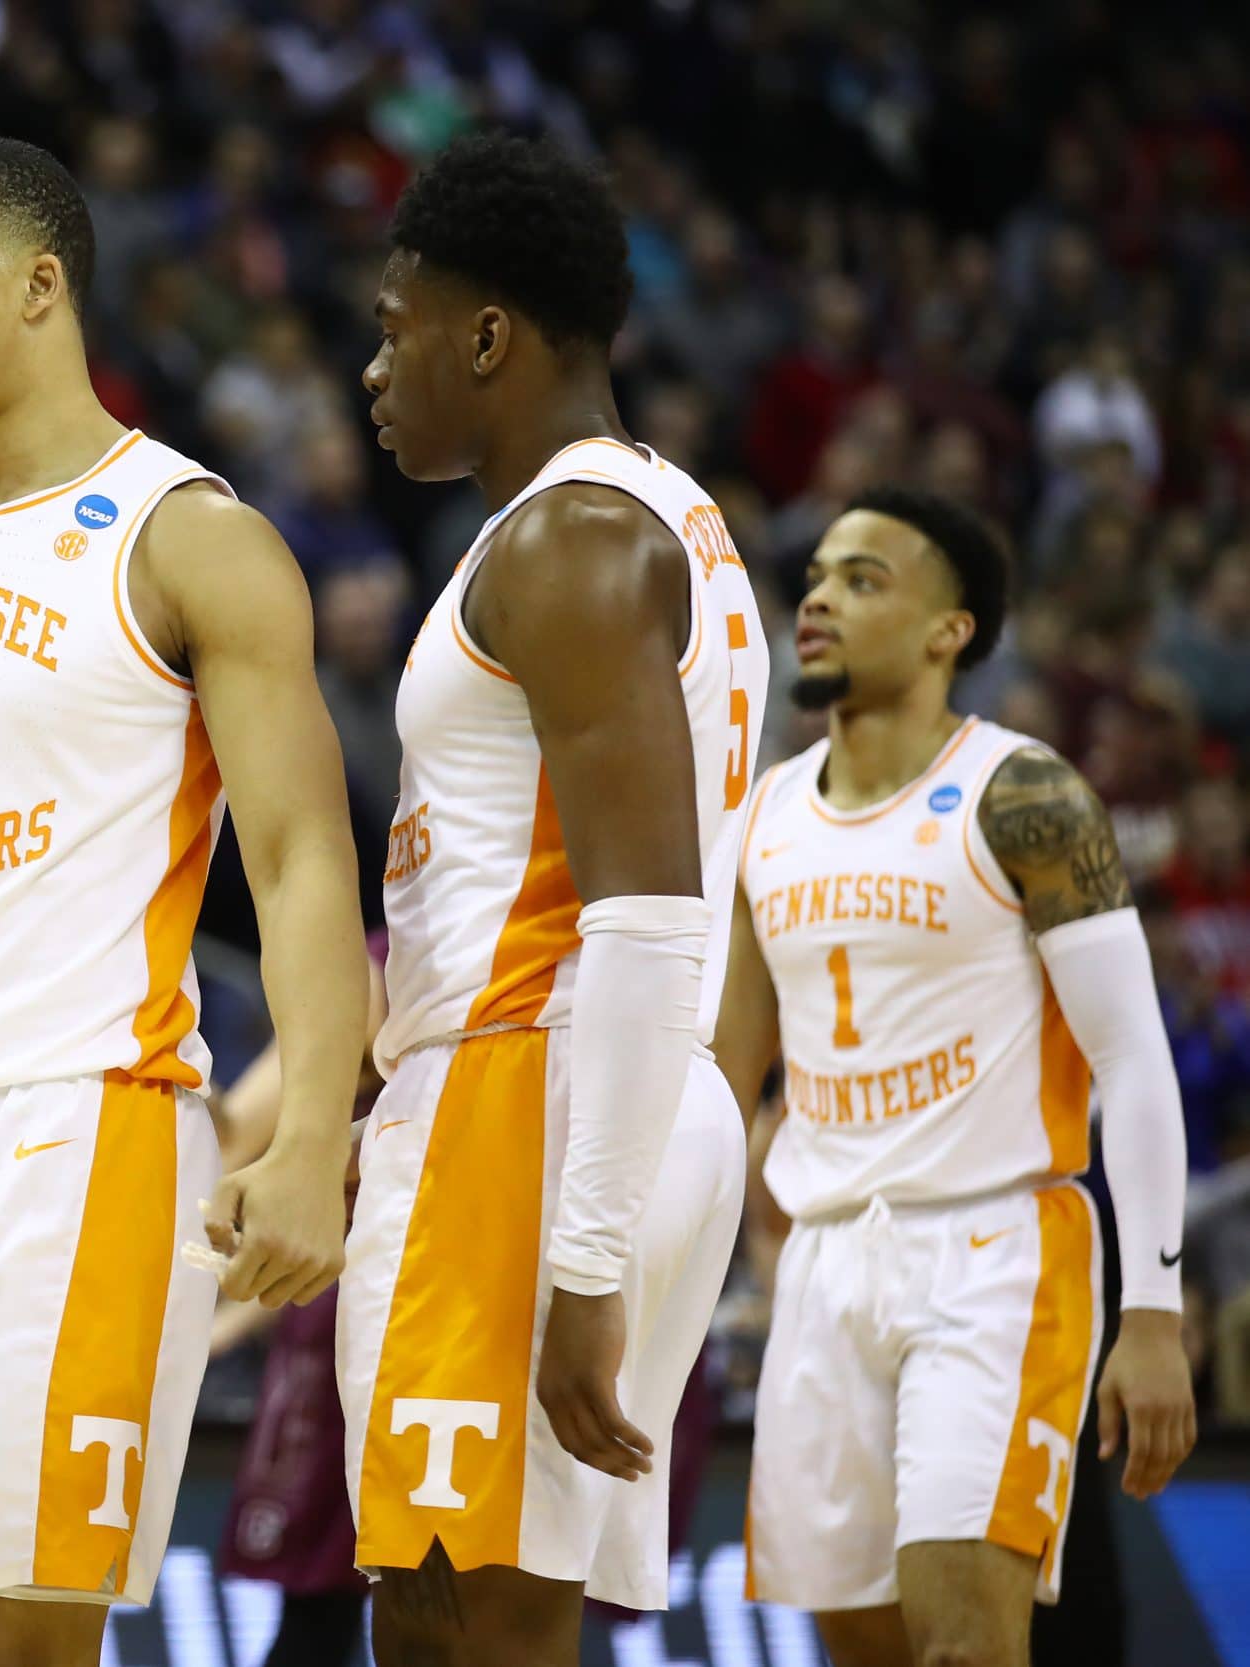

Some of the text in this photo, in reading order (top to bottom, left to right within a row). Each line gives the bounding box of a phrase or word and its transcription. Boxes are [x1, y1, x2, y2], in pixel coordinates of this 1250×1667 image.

[78, 505, 114, 524] NCAA
[722, 612, 749, 812] 5
[826, 944, 862, 1049] 1
[70, 1415, 143, 1530] T
[391, 1398, 500, 1509] T
[1028, 1417, 1070, 1526] T
